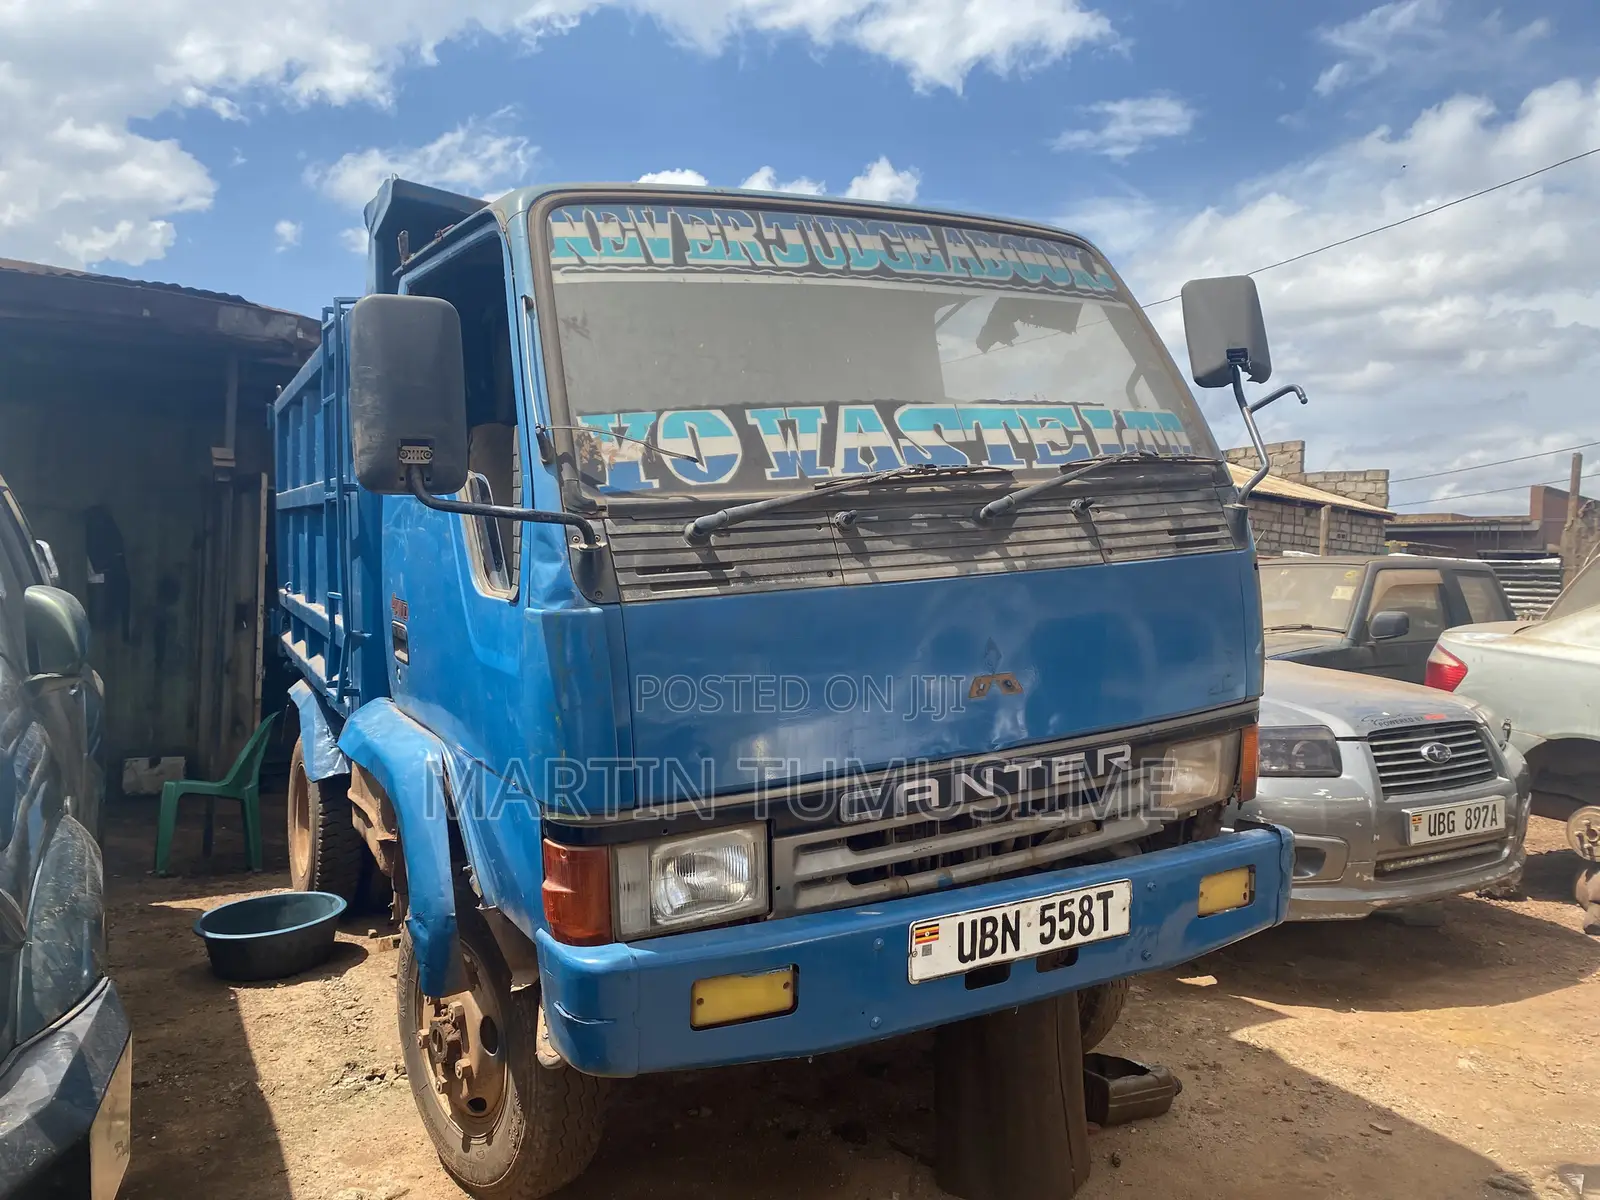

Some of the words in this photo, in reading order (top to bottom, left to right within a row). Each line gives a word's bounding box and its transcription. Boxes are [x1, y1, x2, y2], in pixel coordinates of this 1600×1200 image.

[840, 743, 1132, 824] CANTER
[1428, 811, 1456, 837] UBG
[1465, 803, 1498, 831] 897A
[957, 909, 1021, 964] UBN
[1039, 889, 1114, 945] 558T
